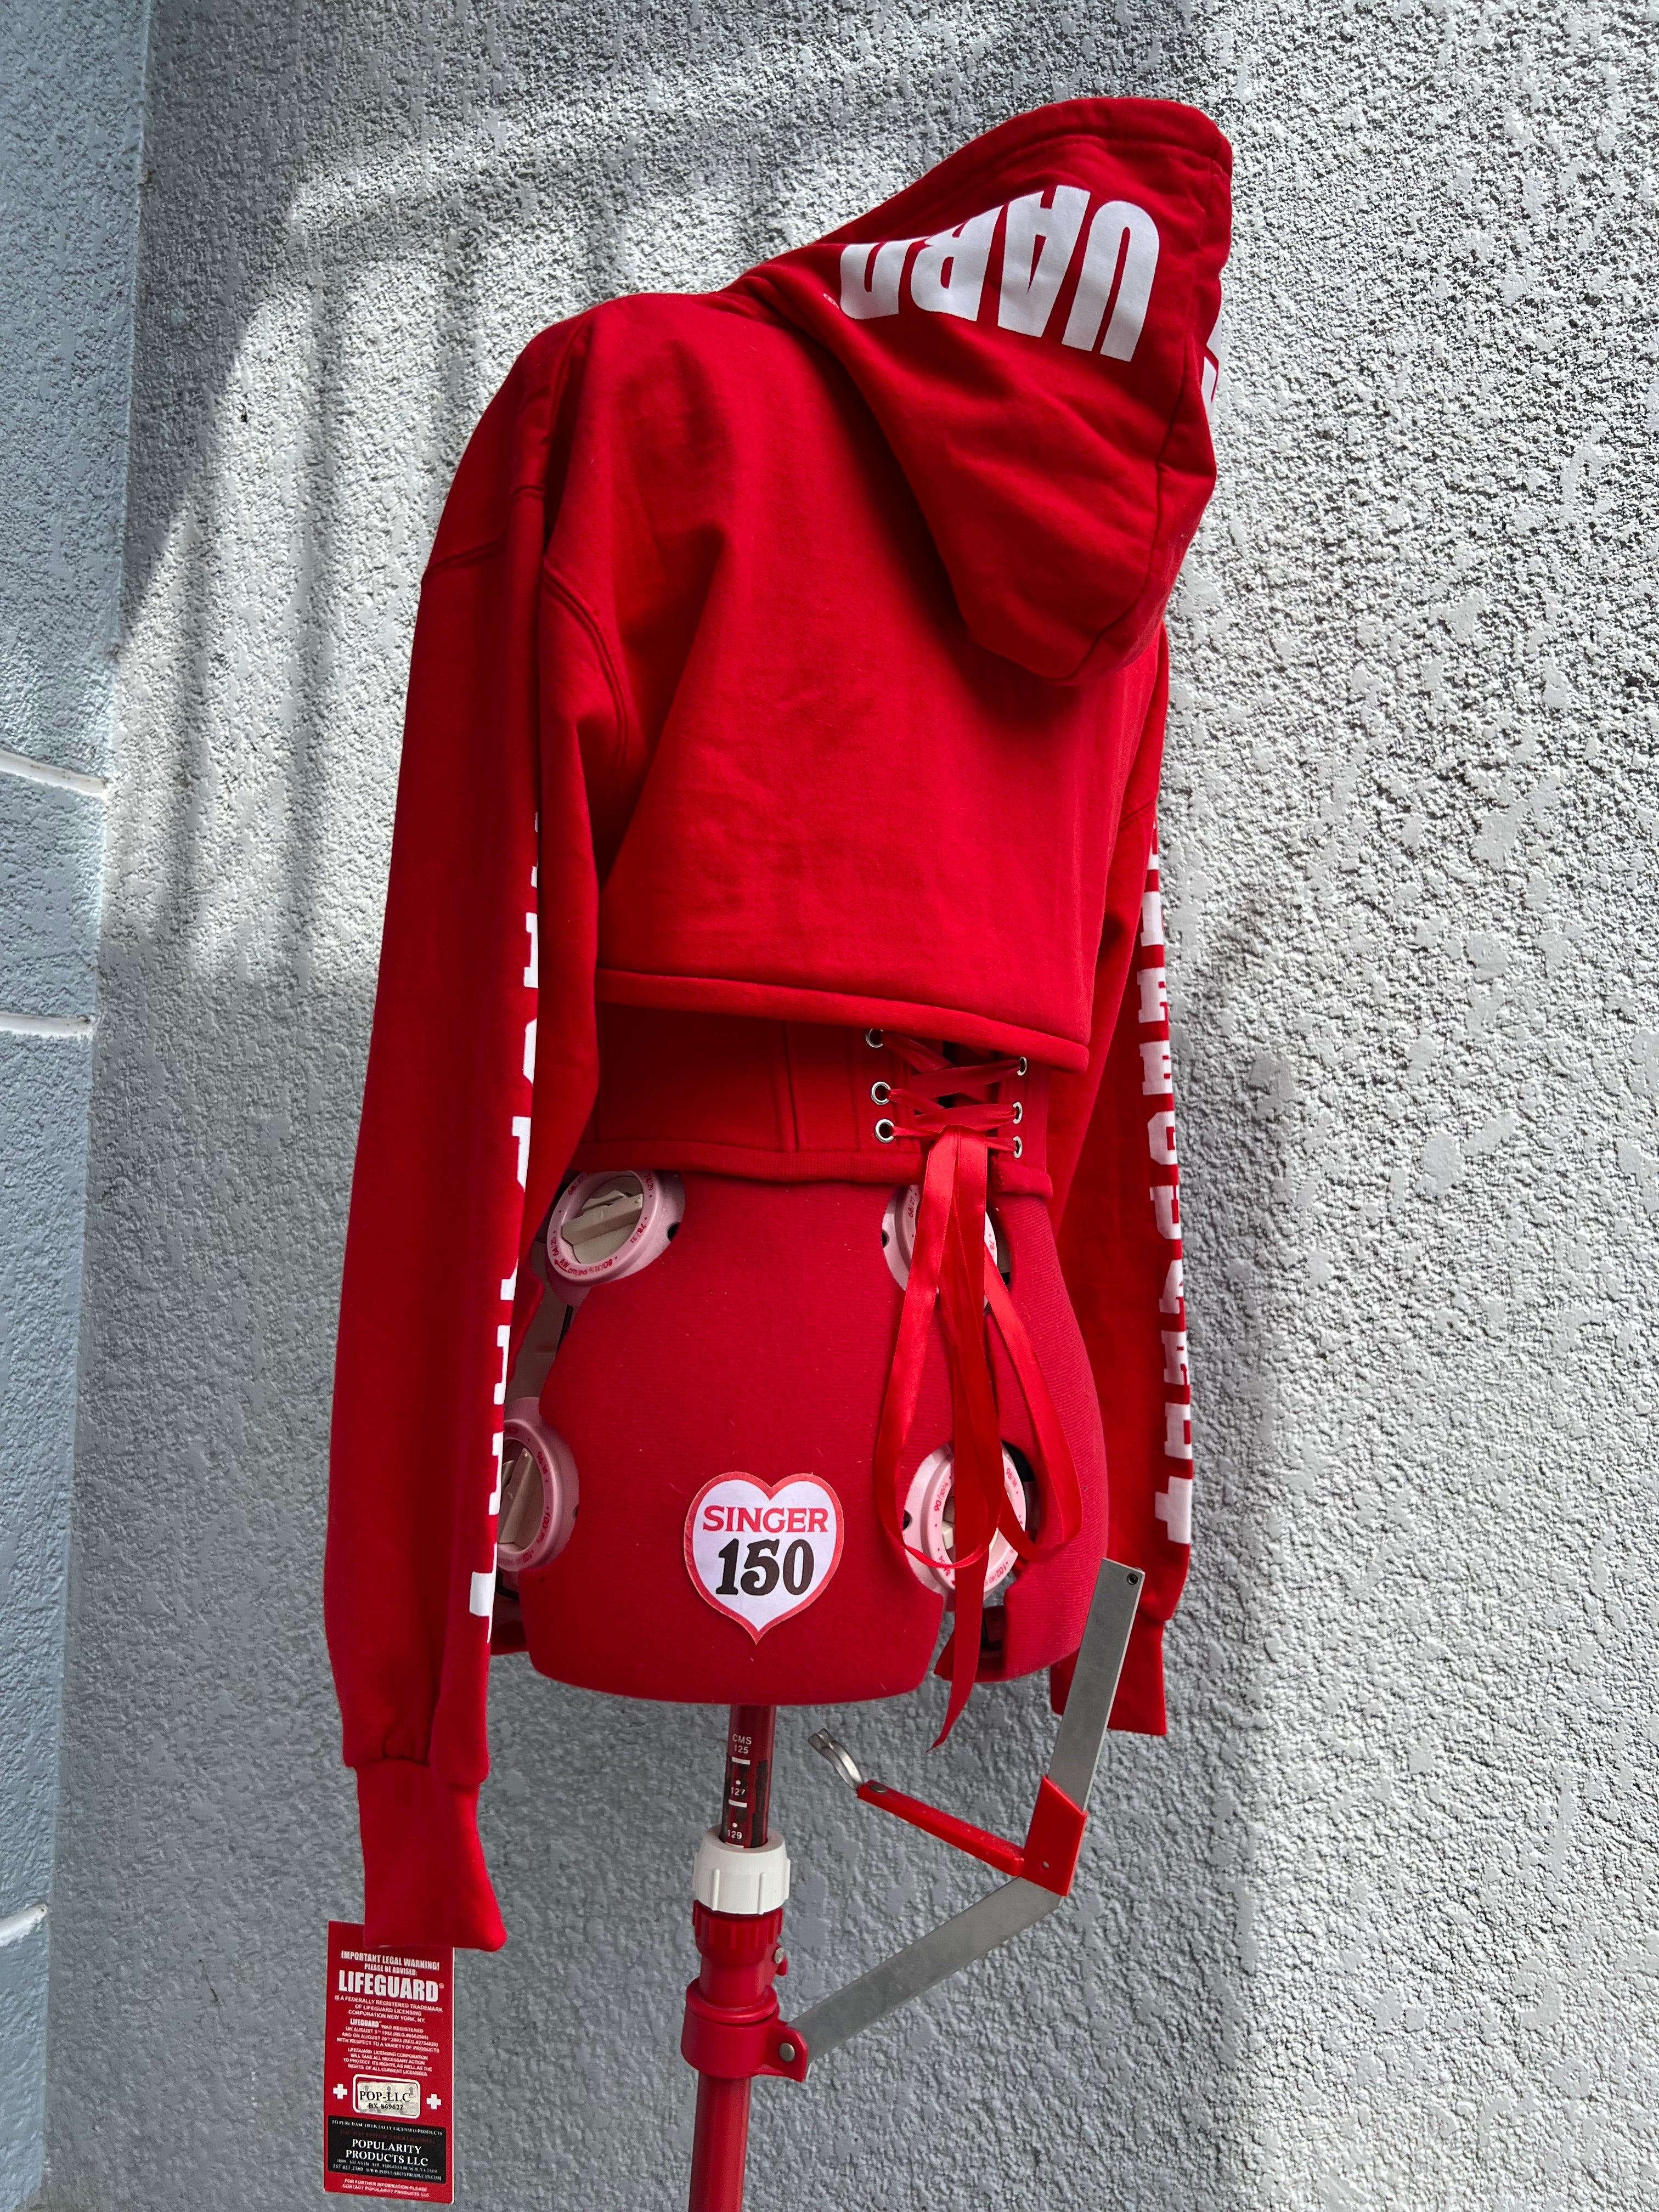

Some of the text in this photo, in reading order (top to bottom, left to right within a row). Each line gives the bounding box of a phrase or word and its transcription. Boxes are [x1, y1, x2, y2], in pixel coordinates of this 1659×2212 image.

[907, 1197, 916, 1218] 68/27
[703, 1505, 828, 1533] SINGER
[716, 1538, 814, 1596] 150
[732, 1734, 752, 1745] CMS
[733, 1745, 749, 1754] 125
[730, 1786, 746, 1795] 127
[727, 1830, 743, 1839] 129
[341, 1950, 439, 1970] IMPORTANT LEGAL WARNING!
[364, 1963, 383, 1972] PLEASE
[345, 1996, 374, 2004] FEDERALLY
[376, 2000, 408, 2008] REGISTERED
[410, 2004, 442, 2012] TRADEMARK
[348, 2009, 386, 2018] CORPORATION
[359, 2091, 410, 2102] POP-LLC
[352, 2138, 421, 2155] POPULARITY
[346, 2148, 404, 2164] PRODUCTS
[407, 2156, 428, 2166] LLC
